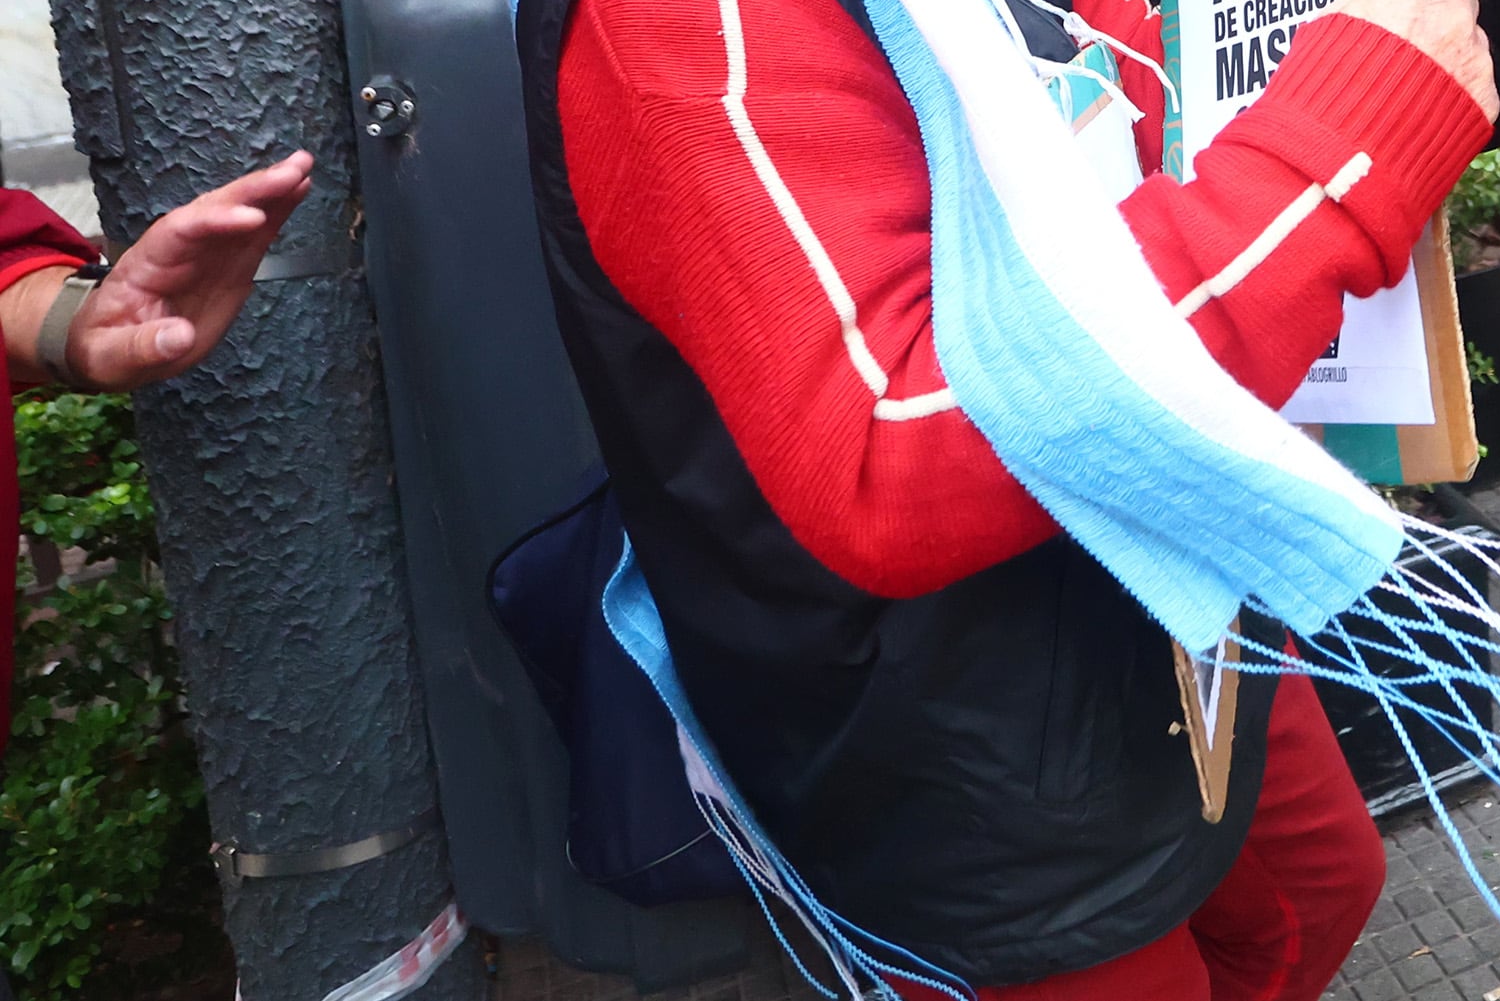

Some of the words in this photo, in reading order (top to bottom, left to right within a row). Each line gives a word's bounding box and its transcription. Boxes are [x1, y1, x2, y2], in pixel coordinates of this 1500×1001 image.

[1214, 6, 1238, 43] DE
[1216, 21, 1308, 101] MAS
[1304, 366, 1347, 383] ABLOGRILLO
